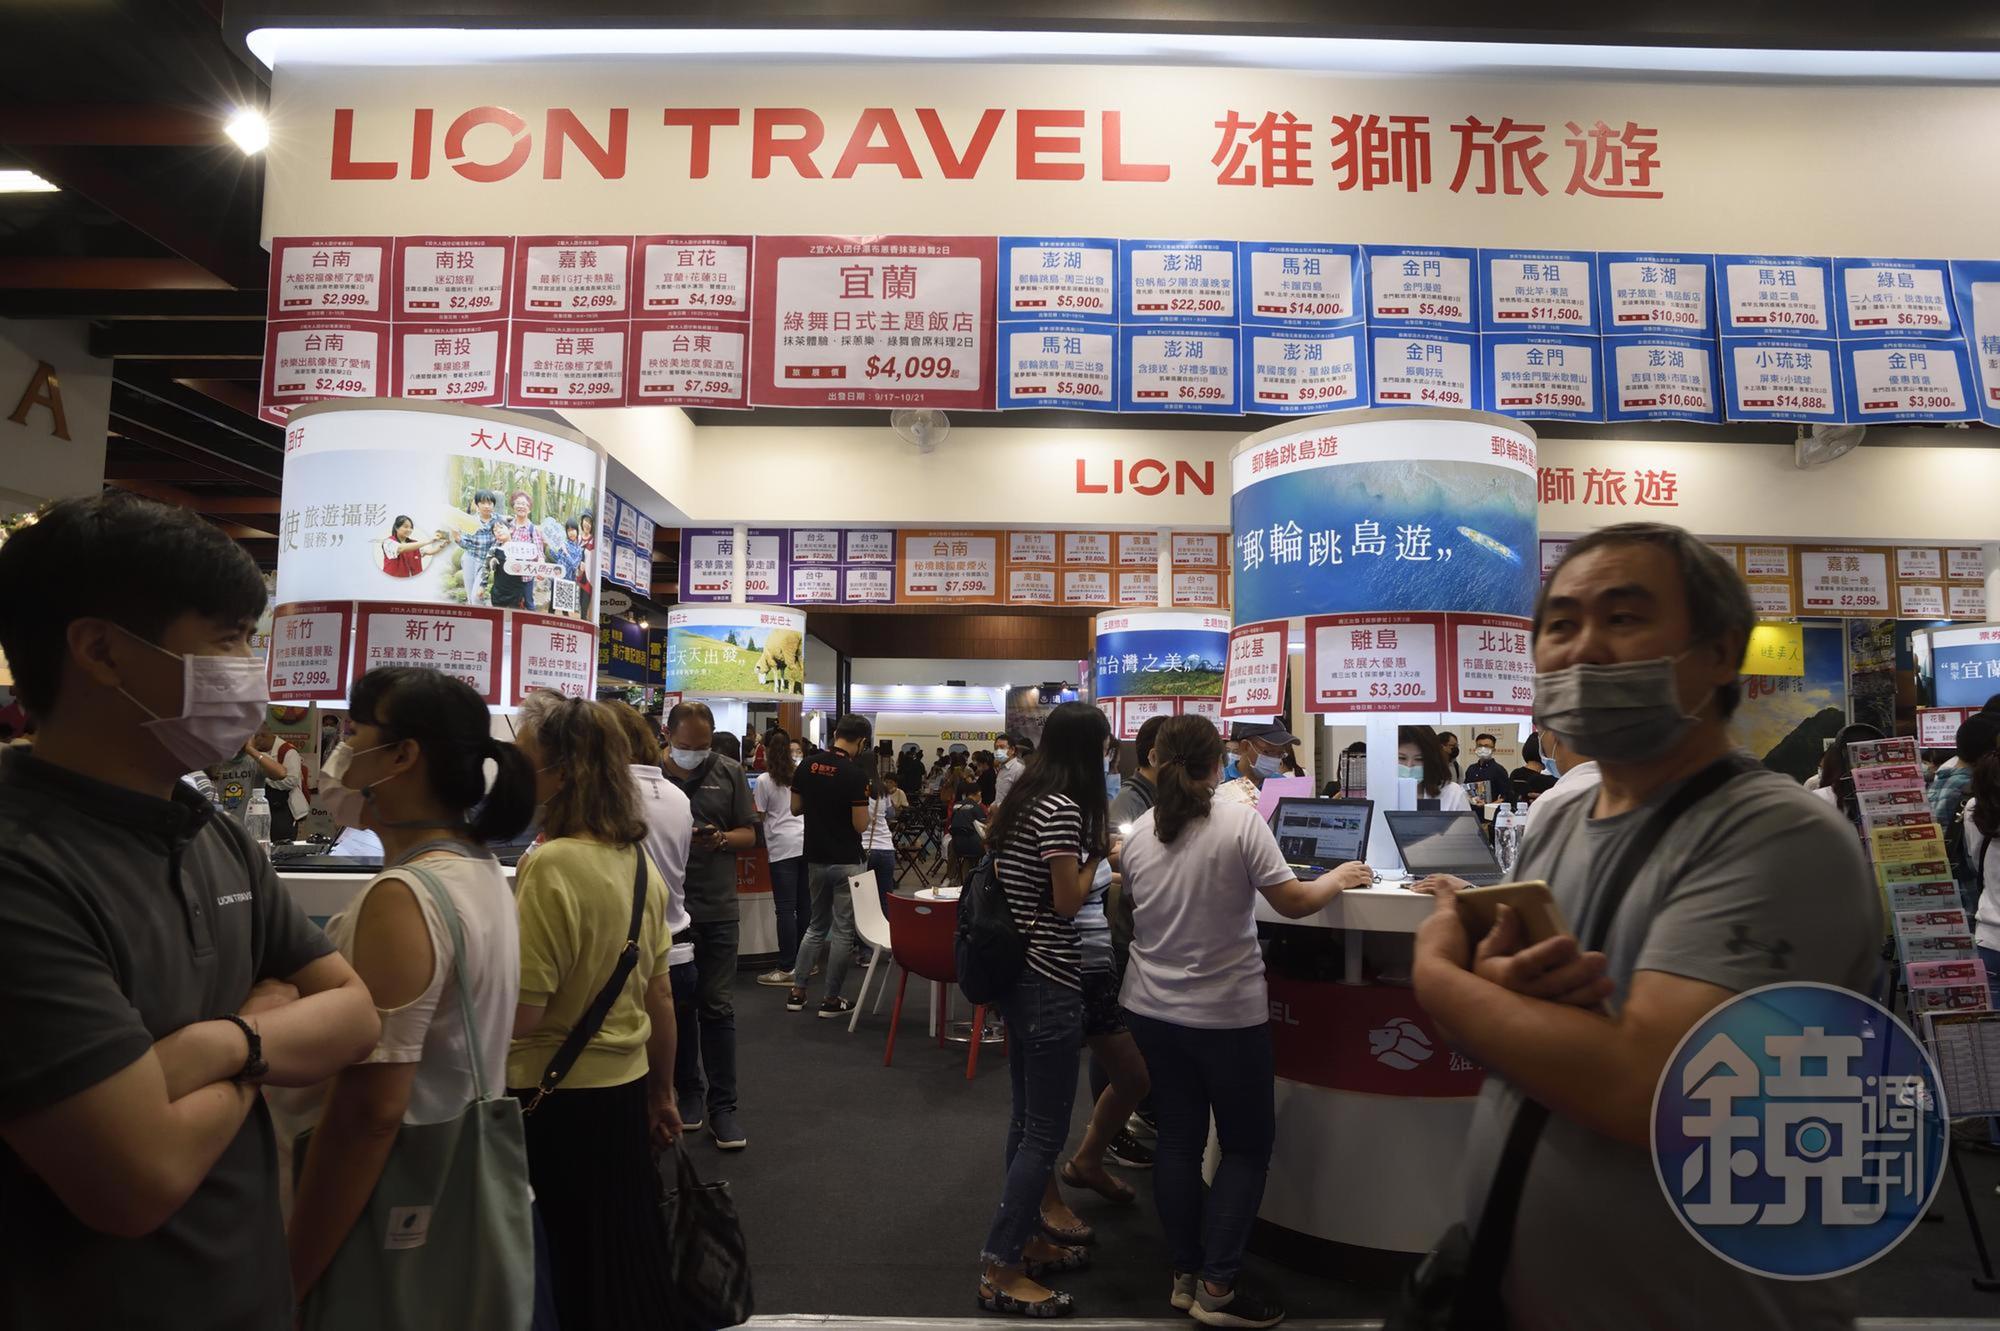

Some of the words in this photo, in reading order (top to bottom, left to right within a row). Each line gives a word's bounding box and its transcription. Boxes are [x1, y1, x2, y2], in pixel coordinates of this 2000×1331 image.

[330, 106, 629, 184] LION
[663, 108, 1172, 183] TRAVEL
[1211, 110, 1664, 199] 雄獅旅遊
[312, 251, 351, 268] 台南
[436, 251, 475, 269] 南投
[558, 250, 597, 268] 嘉義
[677, 249, 716, 267] 宜花
[1042, 252, 1081, 268] 澎湖
[1163, 254, 1202, 271] 澎湖
[1282, 257, 1321, 275] 馬祖
[1403, 259, 1441, 277] 金門
[1523, 264, 1560, 282] 馬祖
[1641, 266, 1676, 285] 澎湖
[286, 273, 374, 283] 大船祝福像極了愛情
[840, 264, 918, 300] 宜蘭
[1759, 269, 1796, 286] 馬祖
[1877, 272, 1914, 289] 綠島
[783, 311, 973, 332] 綠舞日式主題飯店
[304, 333, 344, 351] 台南
[434, 338, 471, 356] 南投
[556, 337, 594, 355] 苗栗
[672, 335, 712, 352] 台東
[1042, 336, 1081, 354] 馬祖
[1164, 340, 1203, 358] 澎湖
[1283, 343, 1322, 361] 澎湖
[1406, 343, 1443, 362] 金門
[1526, 348, 1564, 367] 金門
[1648, 349, 1684, 368] 澎湖
[1755, 351, 1813, 369] 小琉球
[1888, 352, 1926, 370] 金門
[7, 360, 72, 441] A
[471, 428, 555, 462] 大人囝仔
[1252, 435, 1338, 474] 郵輪跳島遊
[1076, 458, 1214, 496] LION
[304, 503, 387, 528] 旅遊攝影
[933, 541, 968, 557] 台南
[1827, 556, 1860, 572] 嘉義
[287, 618, 314, 640] 新竹
[406, 619, 454, 641] 新竹
[551, 632, 578, 653] 南投
[1351, 629, 1398, 650] 離島
[1479, 630, 1526, 654] 北北基
[1344, 657, 1407, 669] 旅展大優惠
